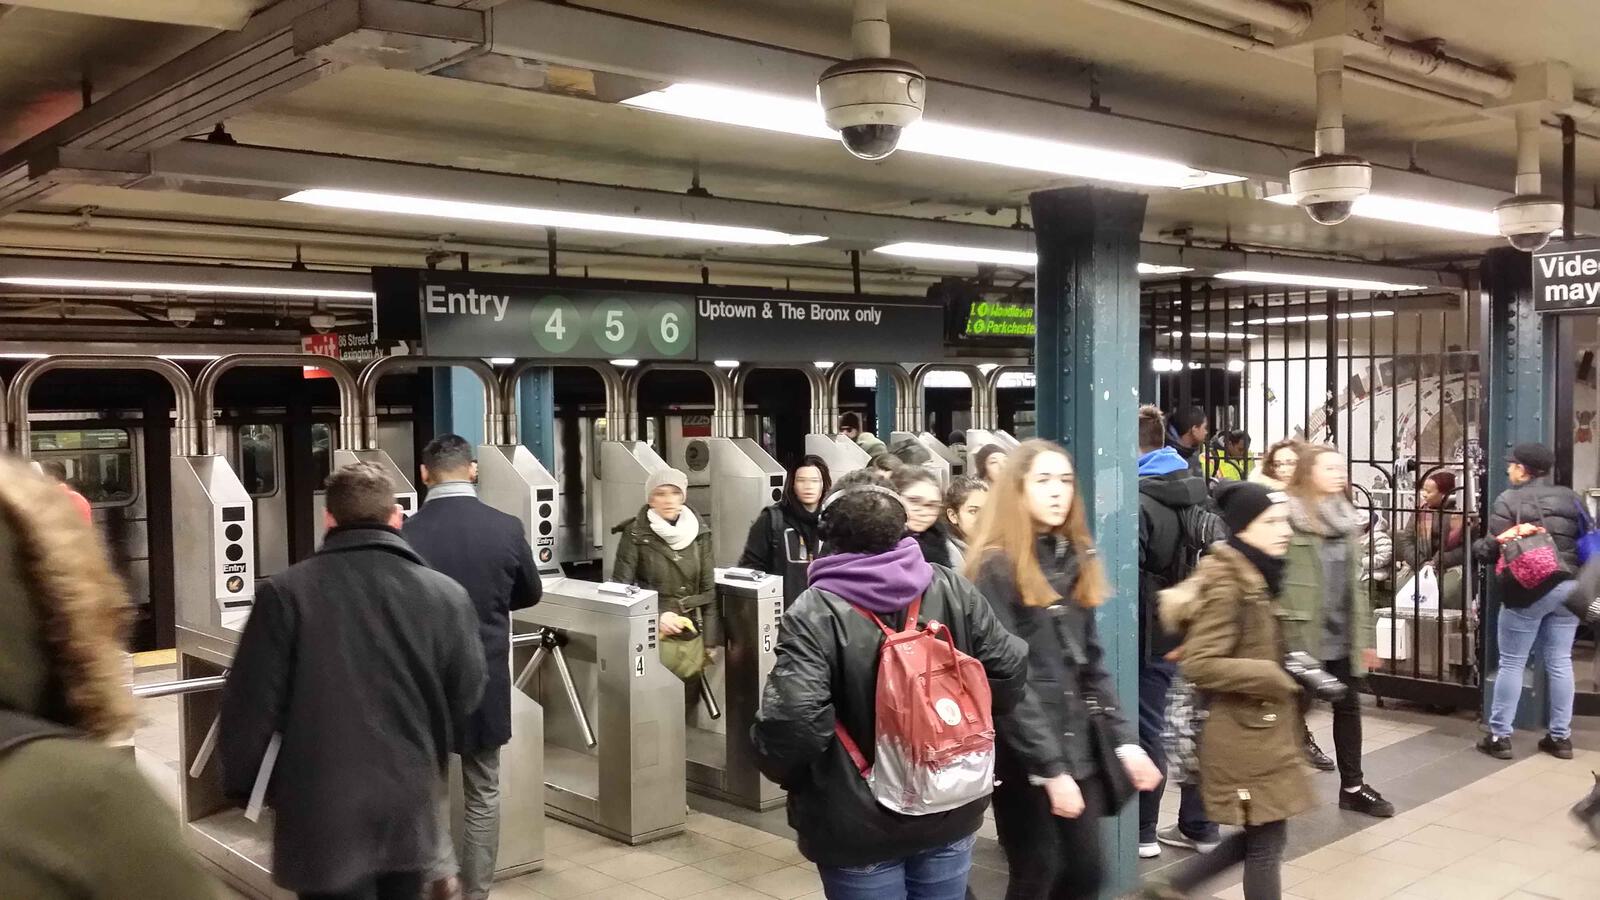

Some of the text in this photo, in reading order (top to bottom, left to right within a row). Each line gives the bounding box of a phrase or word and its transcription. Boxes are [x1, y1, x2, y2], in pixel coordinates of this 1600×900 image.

[1539, 254, 1600, 278] Vide
[1545, 281, 1600, 305] may
[425, 284, 680, 344] Entry 4 5 6
[699, 299, 882, 325] Uptown & The Bronx only
[348, 333, 369, 347] Street
[339, 347, 373, 363] Lexington
[537, 537, 554, 547] Entry
[223, 563, 245, 574] Entry
[764, 634, 771, 652] 5
[636, 656, 644, 675] 4
